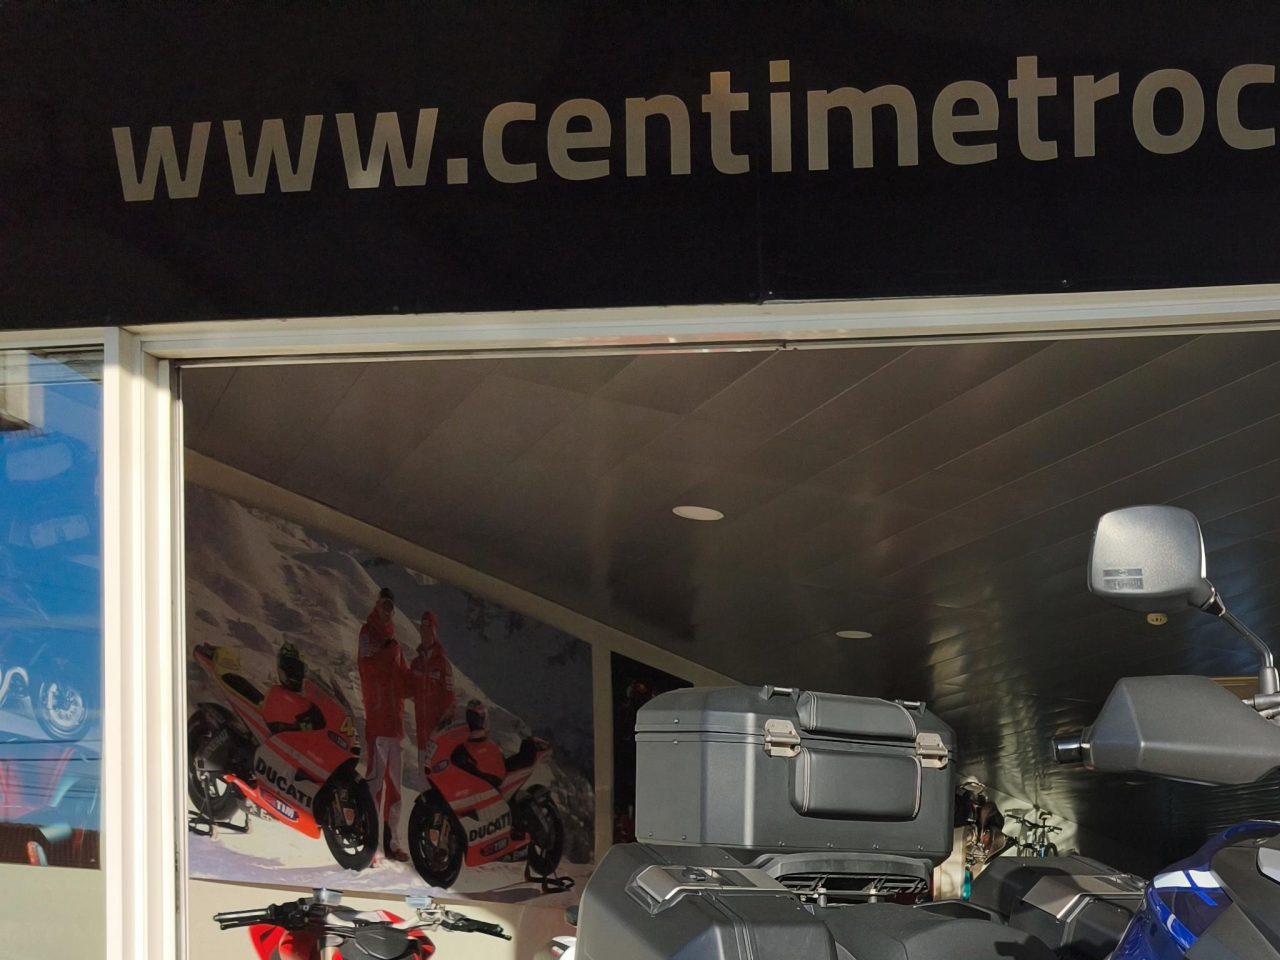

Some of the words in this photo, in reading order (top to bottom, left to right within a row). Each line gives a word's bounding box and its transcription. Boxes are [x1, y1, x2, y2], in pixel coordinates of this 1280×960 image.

[256, 757, 312, 808] DUCATI
[275, 799, 296, 819] TIM
[469, 813, 512, 842] DUCATI
